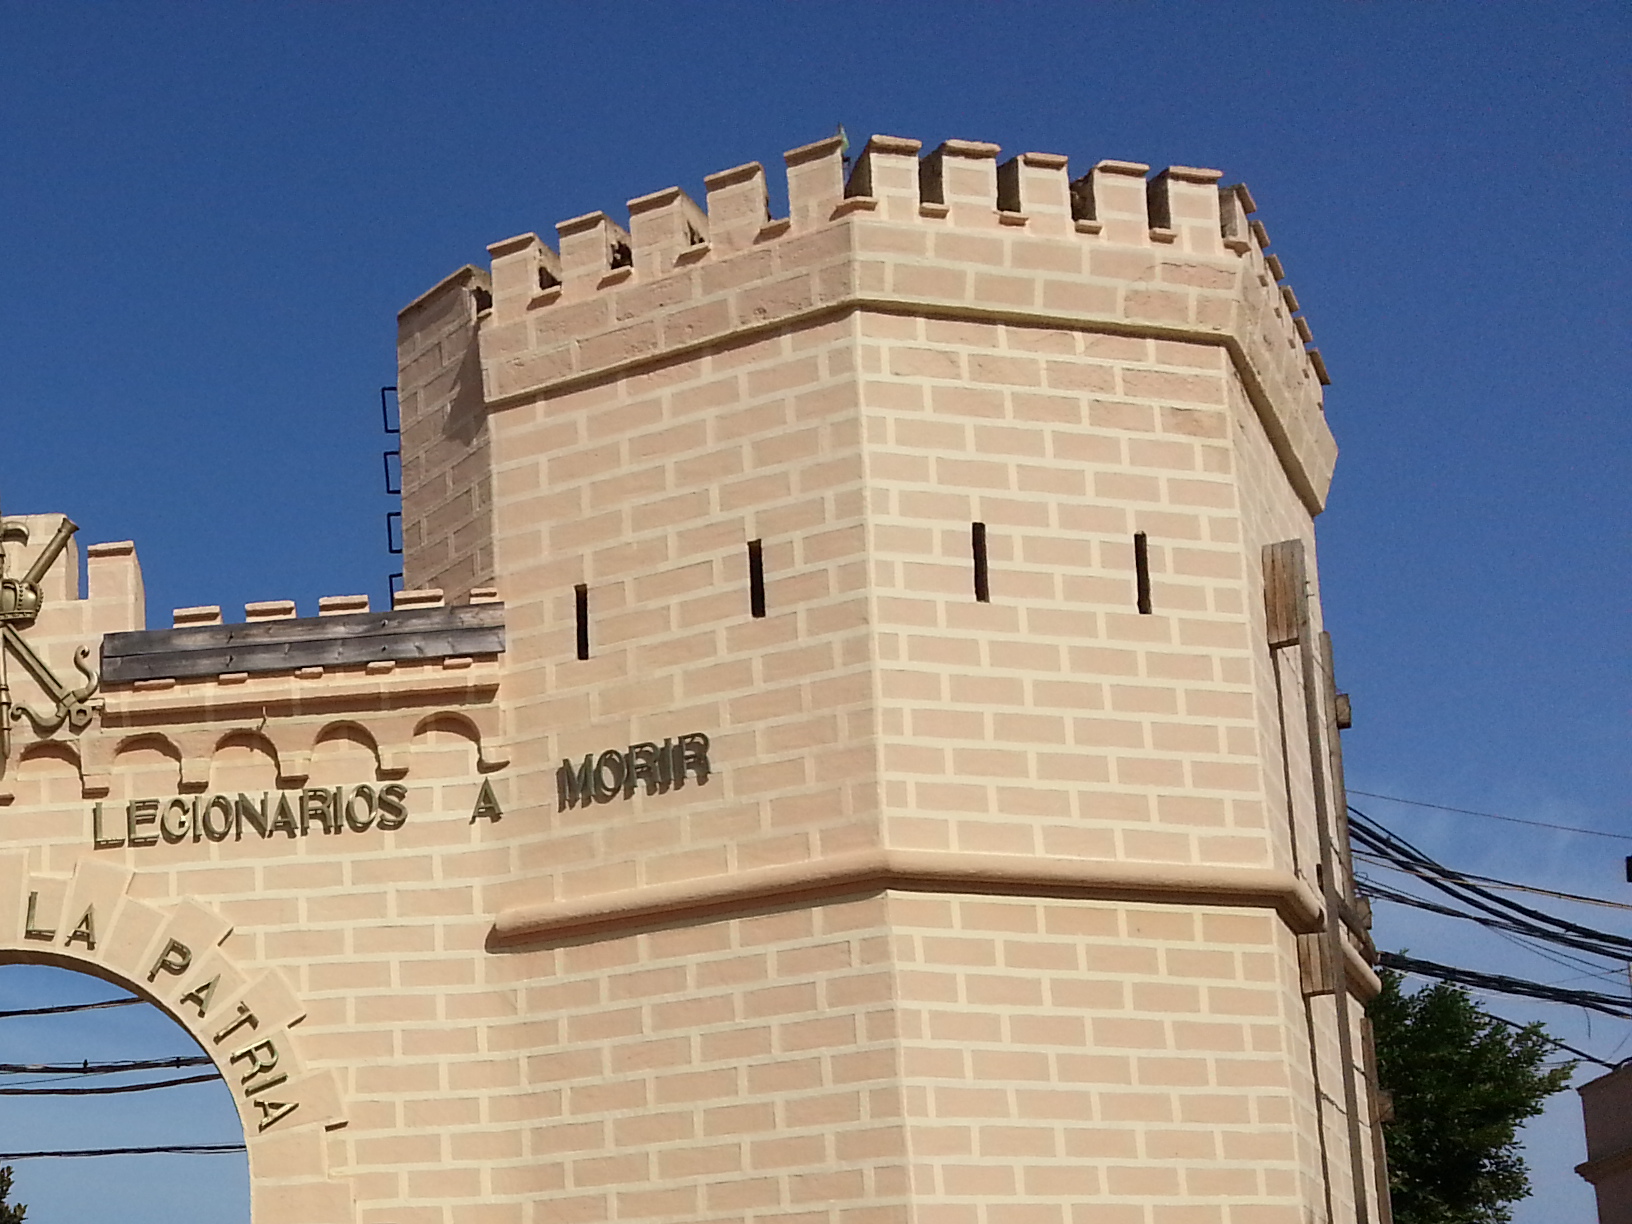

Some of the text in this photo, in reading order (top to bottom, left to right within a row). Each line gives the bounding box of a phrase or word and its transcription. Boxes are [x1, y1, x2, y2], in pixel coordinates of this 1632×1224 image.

[93, 732, 711, 851] LEGIONARIOS A MORIR
[24, 890, 97, 951] LA
[146, 937, 300, 1133] PATRIA
